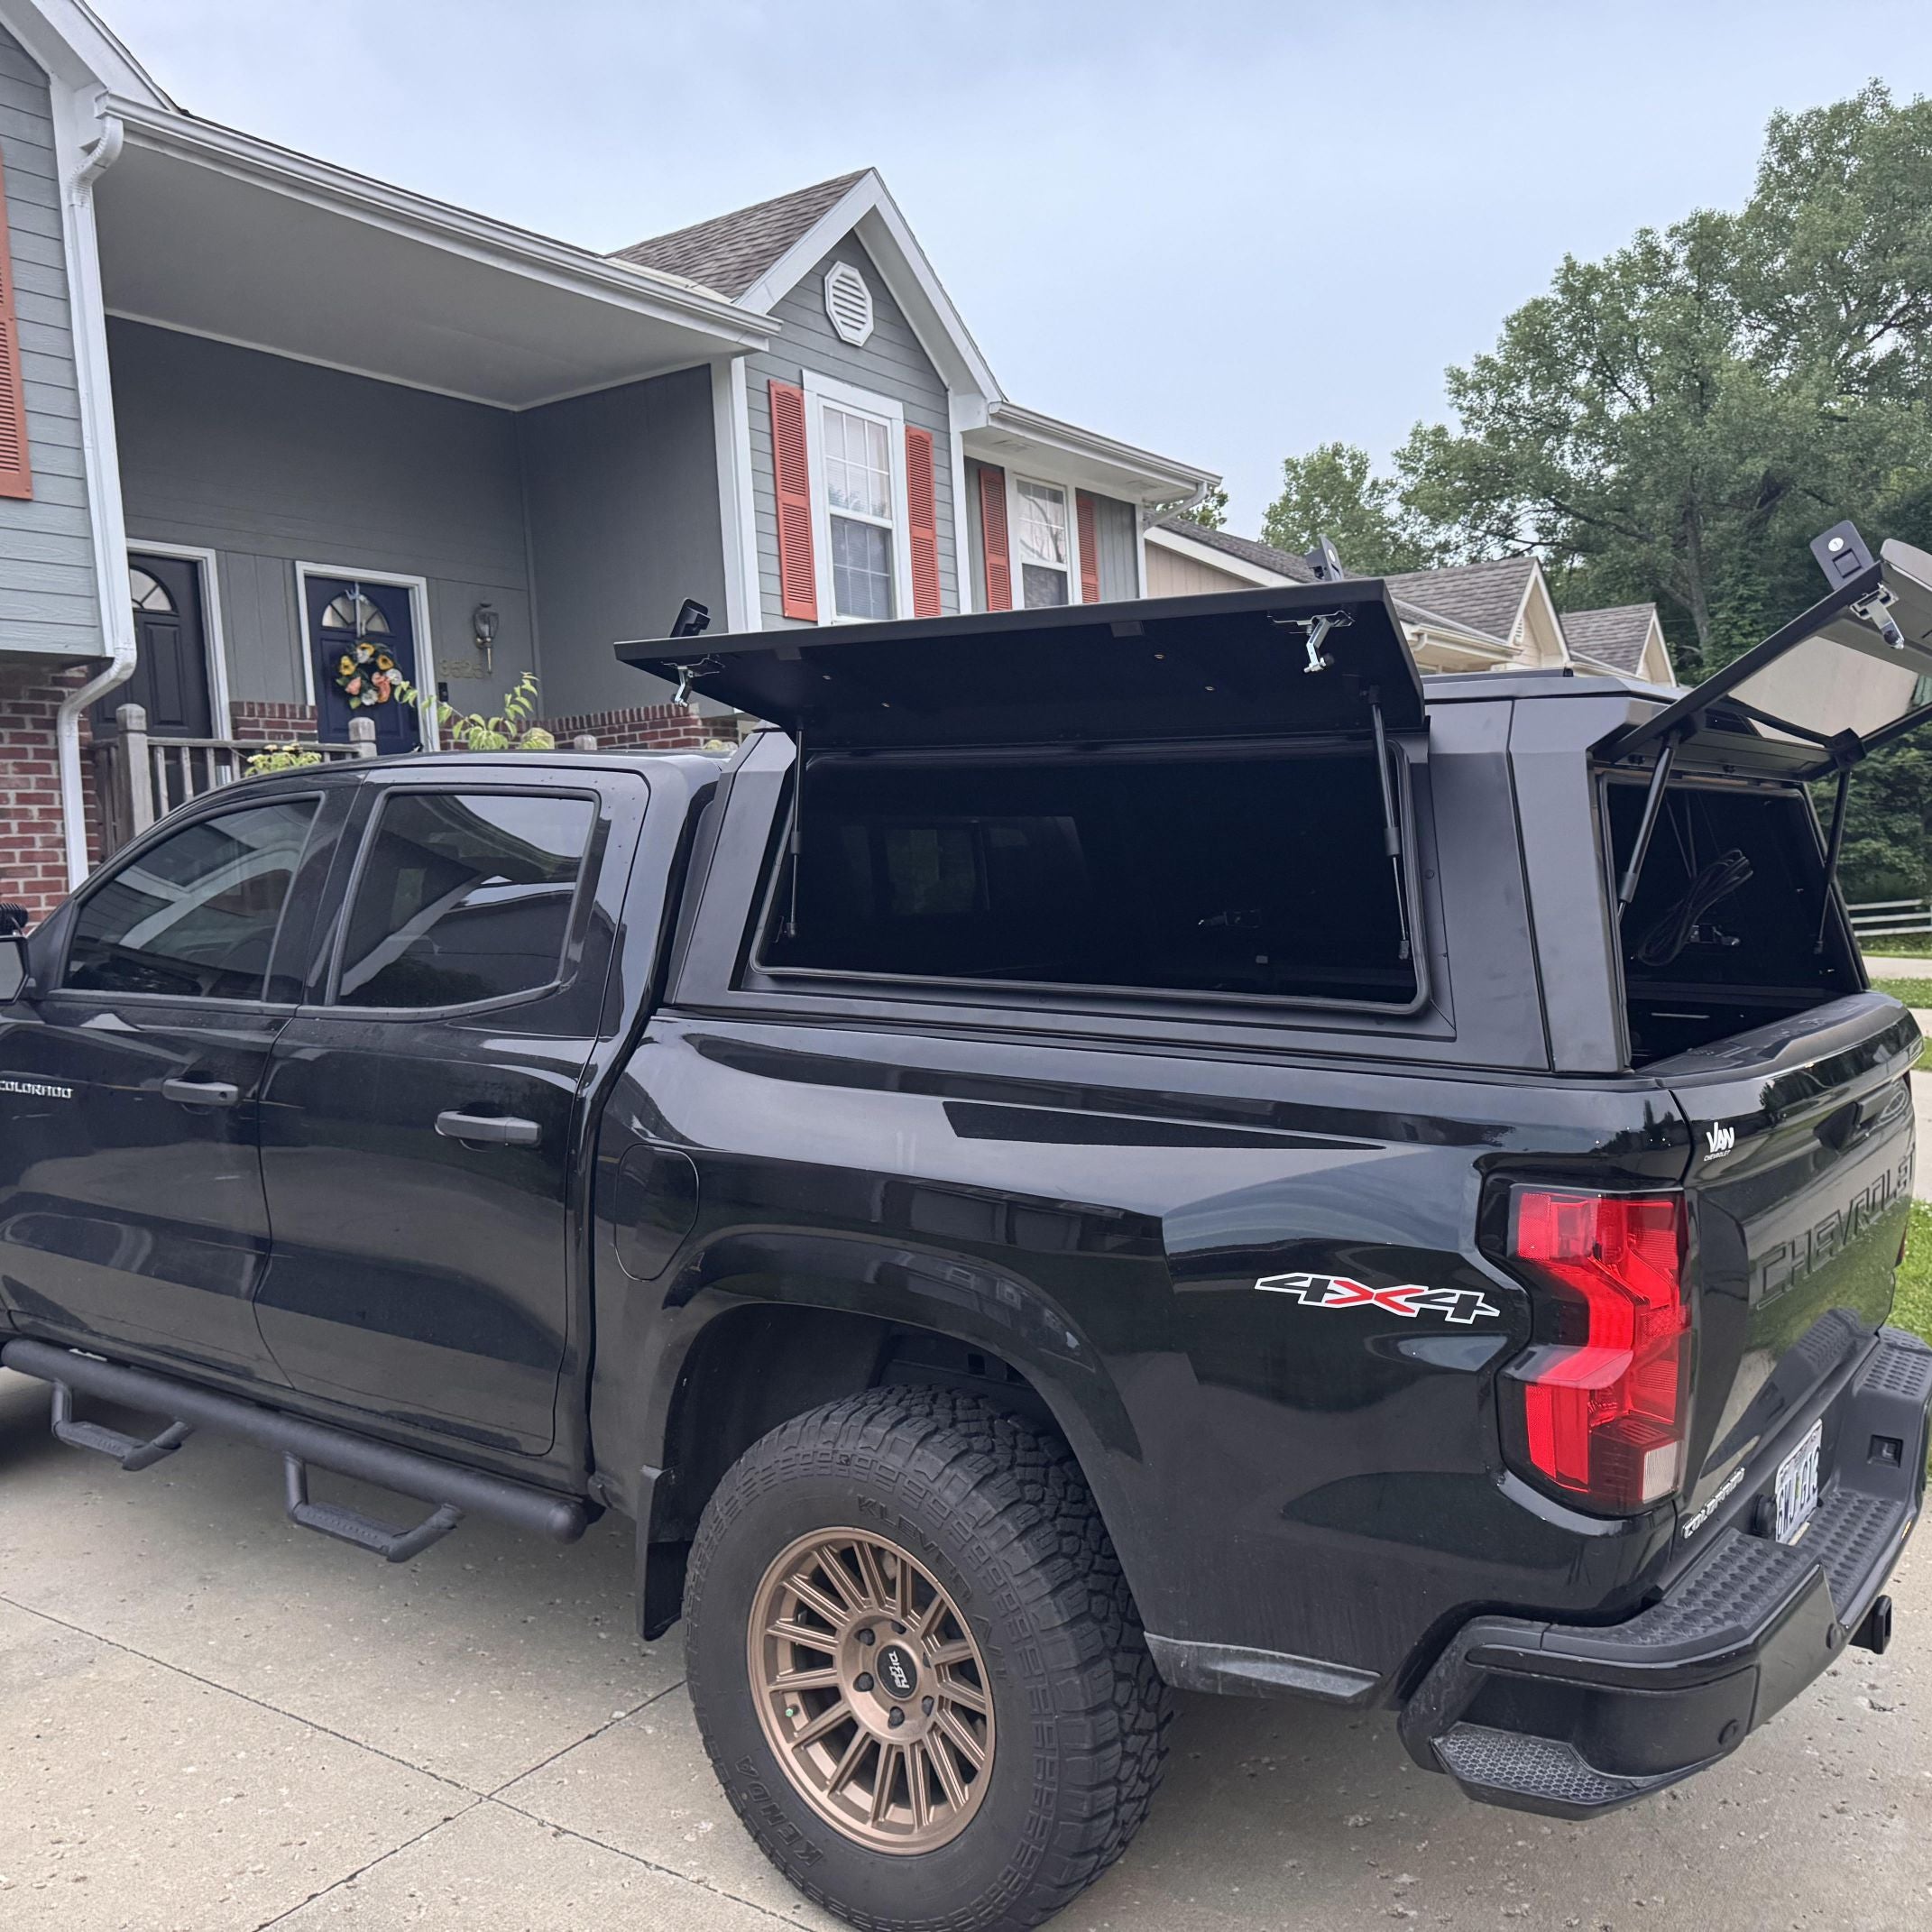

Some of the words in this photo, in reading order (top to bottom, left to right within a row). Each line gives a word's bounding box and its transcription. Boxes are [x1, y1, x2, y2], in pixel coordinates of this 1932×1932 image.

[1706, 1121, 1735, 1154] VAN
[1682, 1467, 1746, 1540] COLORADO
[735, 1754, 823, 1868] KENDA
